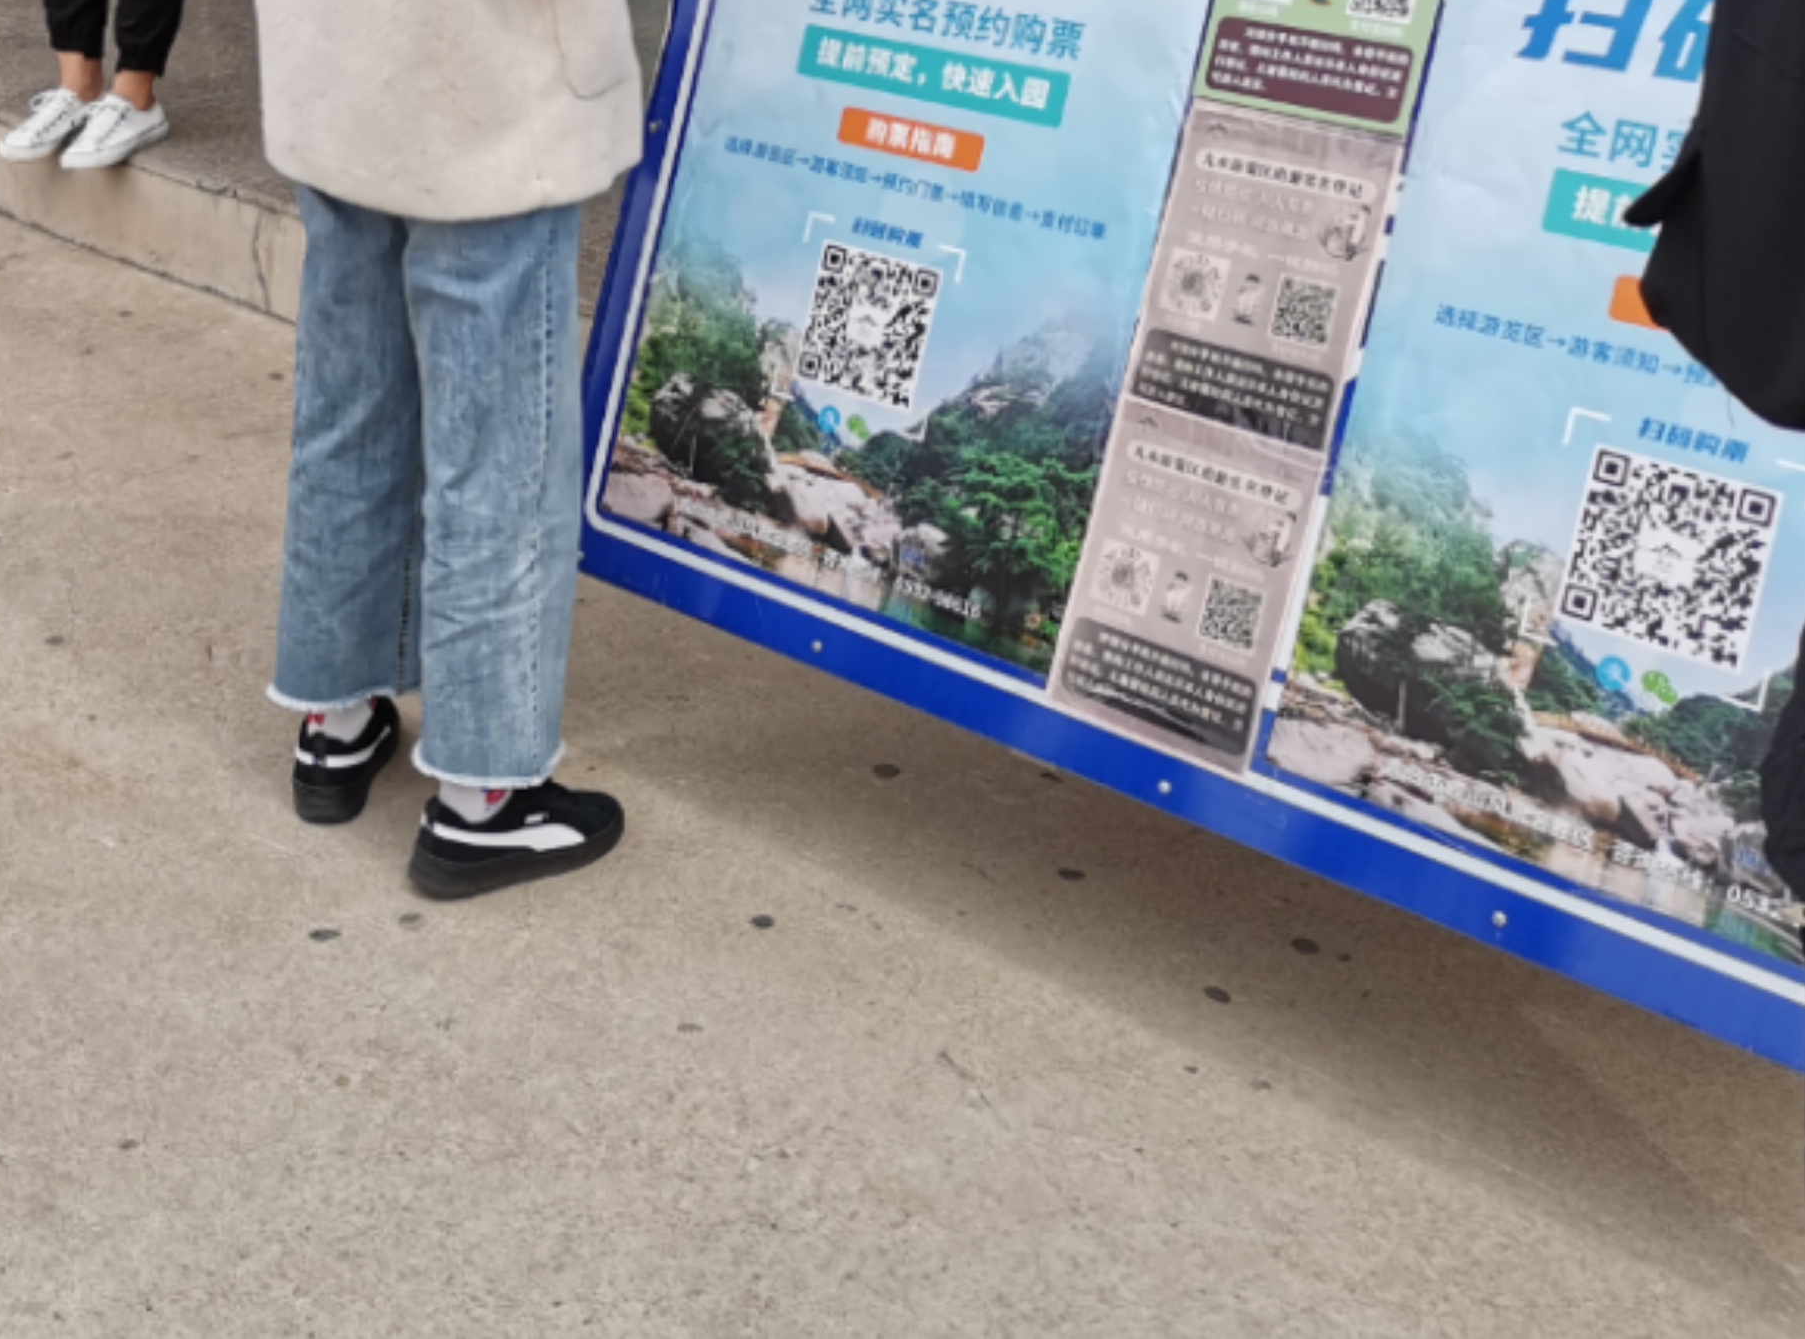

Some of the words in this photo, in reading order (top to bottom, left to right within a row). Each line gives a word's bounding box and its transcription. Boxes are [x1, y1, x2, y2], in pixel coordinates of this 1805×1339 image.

[816, 35, 1050, 112] 提前预定，快速入园
[865, 116, 957, 161] 购票指南
[1433, 303, 1546, 349] 选择游览区
[1567, 334, 1660, 376] 游客须知
[1638, 416, 1751, 464] 扫码购票
